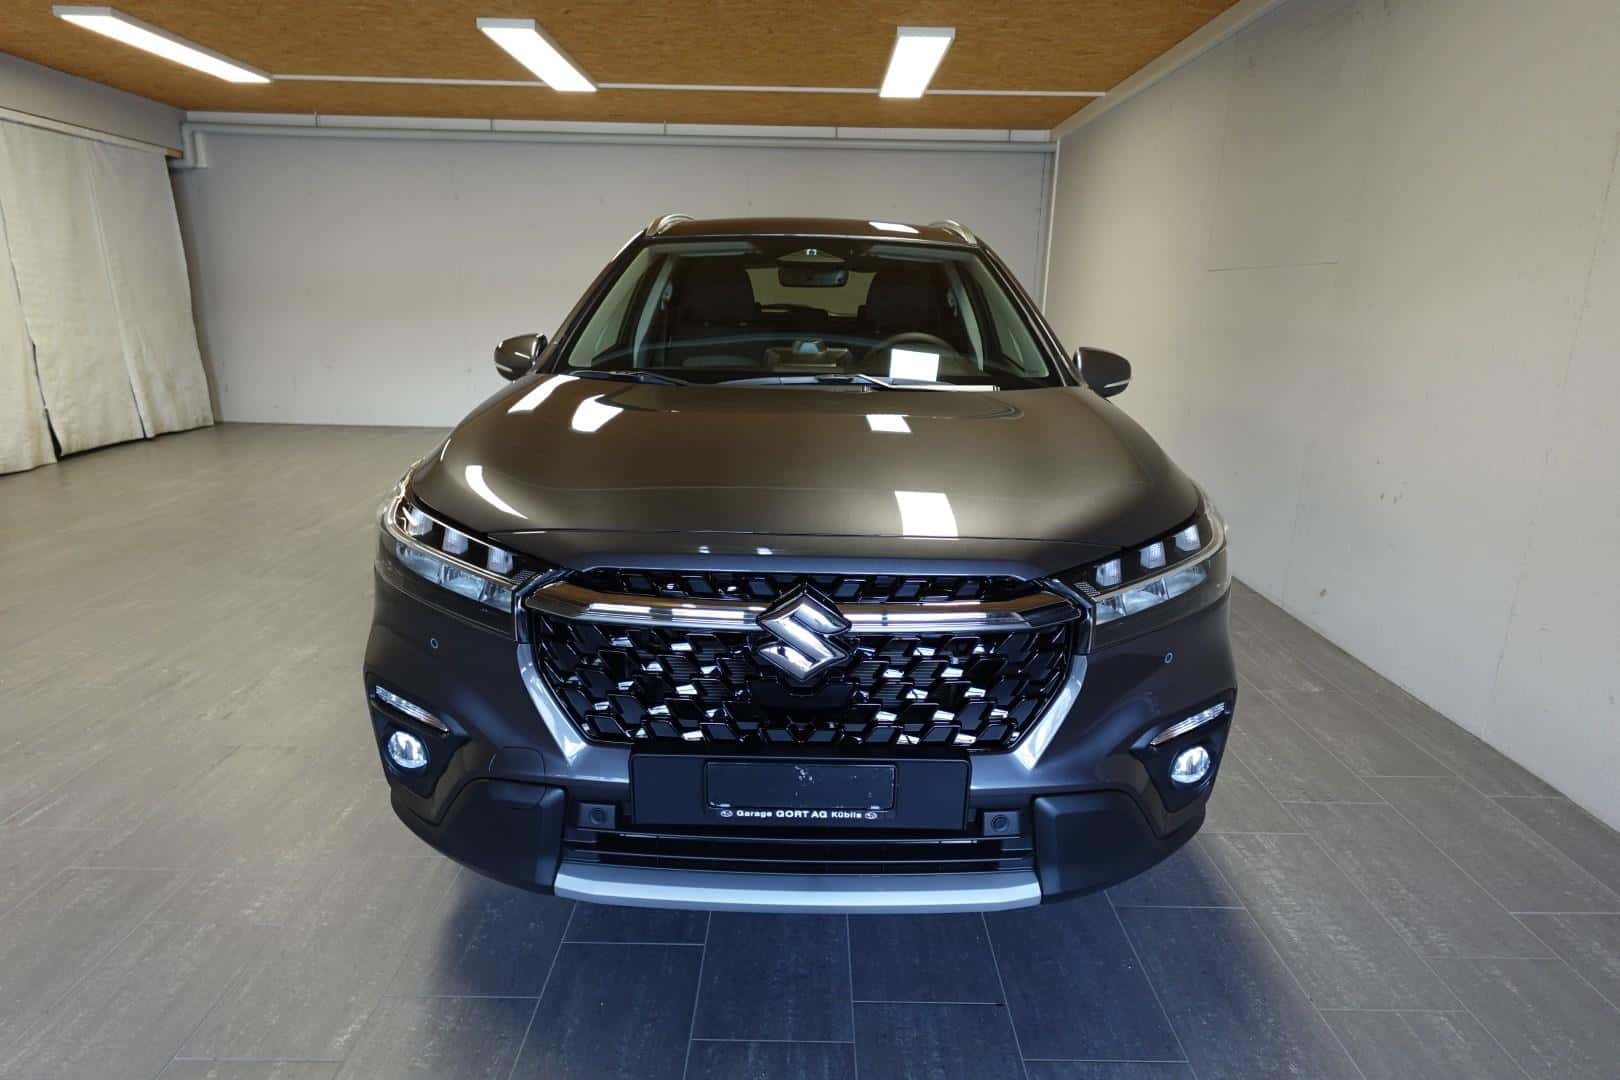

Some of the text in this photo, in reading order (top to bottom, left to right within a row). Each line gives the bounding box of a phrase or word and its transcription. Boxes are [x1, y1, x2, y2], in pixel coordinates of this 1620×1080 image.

[736, 809, 773, 819] Garage
[775, 809, 810, 819] GORT
[810, 810, 828, 819] AG
